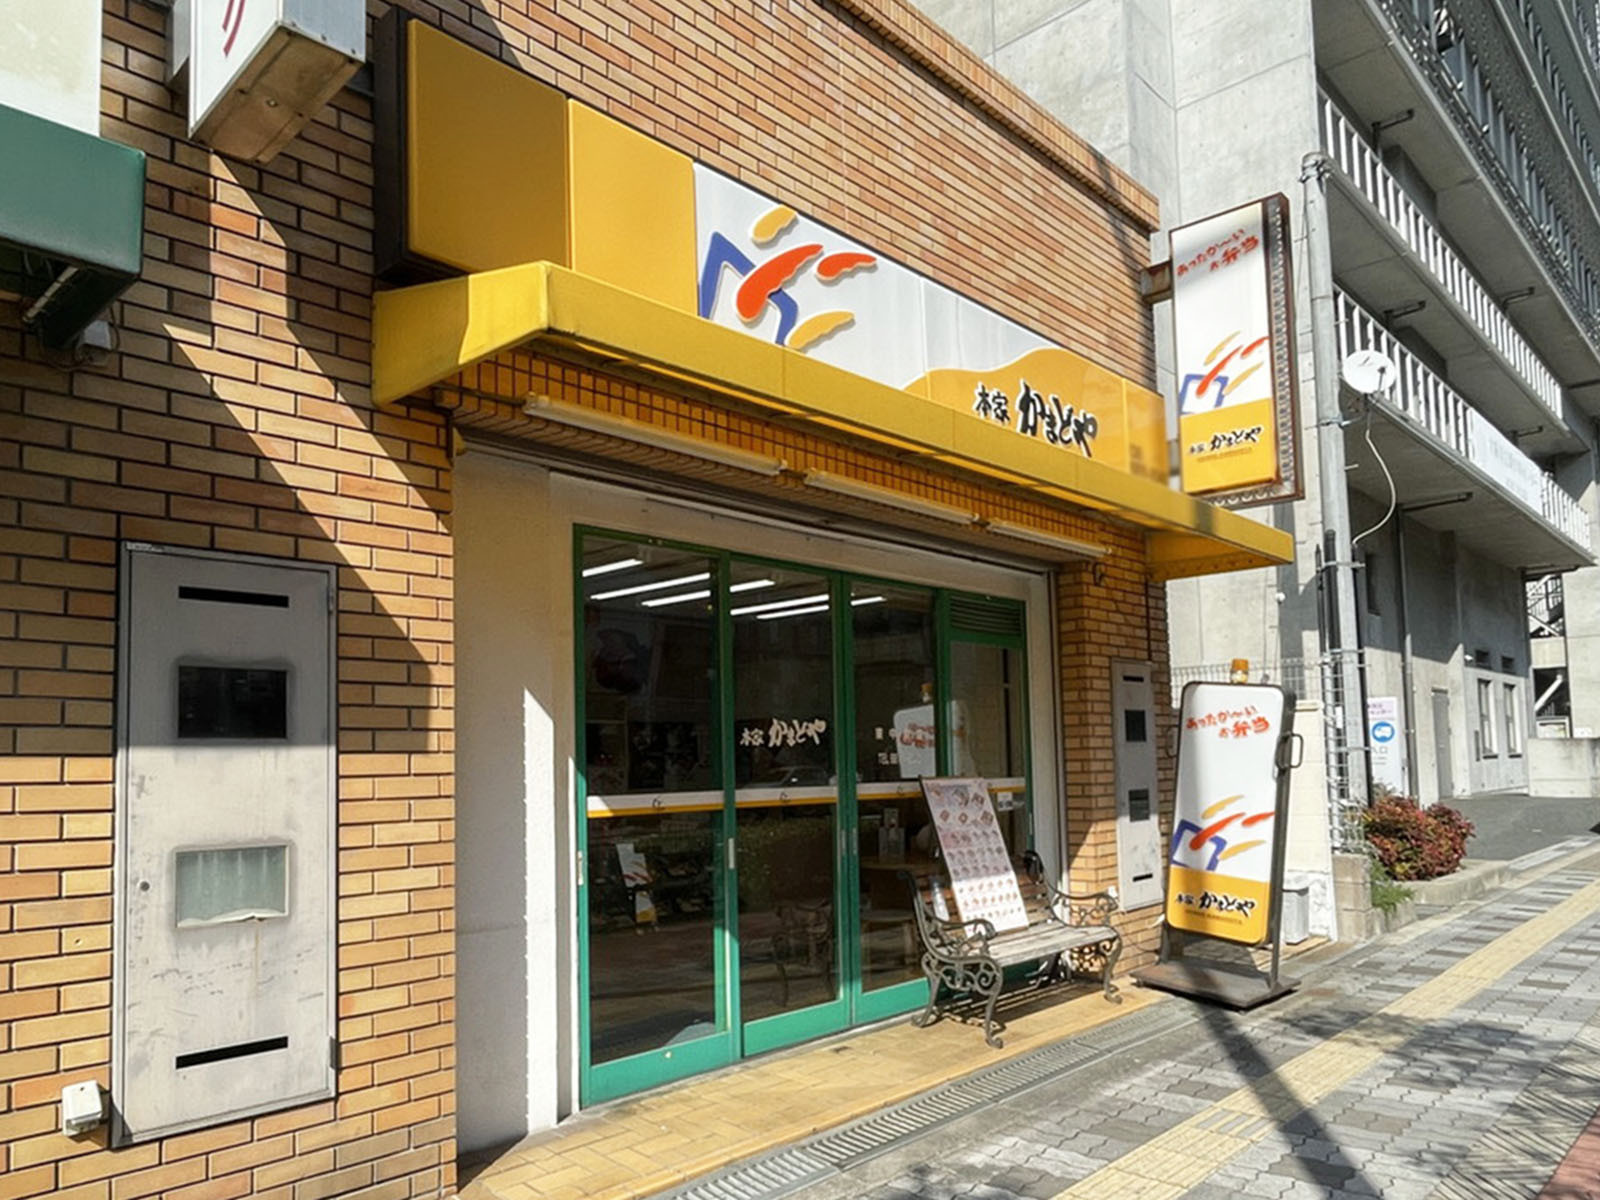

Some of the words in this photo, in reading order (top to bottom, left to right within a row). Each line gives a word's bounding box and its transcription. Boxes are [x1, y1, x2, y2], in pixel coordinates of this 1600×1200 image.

[1017, 379, 1098, 458] かまどや
[767, 718, 827, 749] かまどや
[1198, 890, 1256, 918] かまどや
